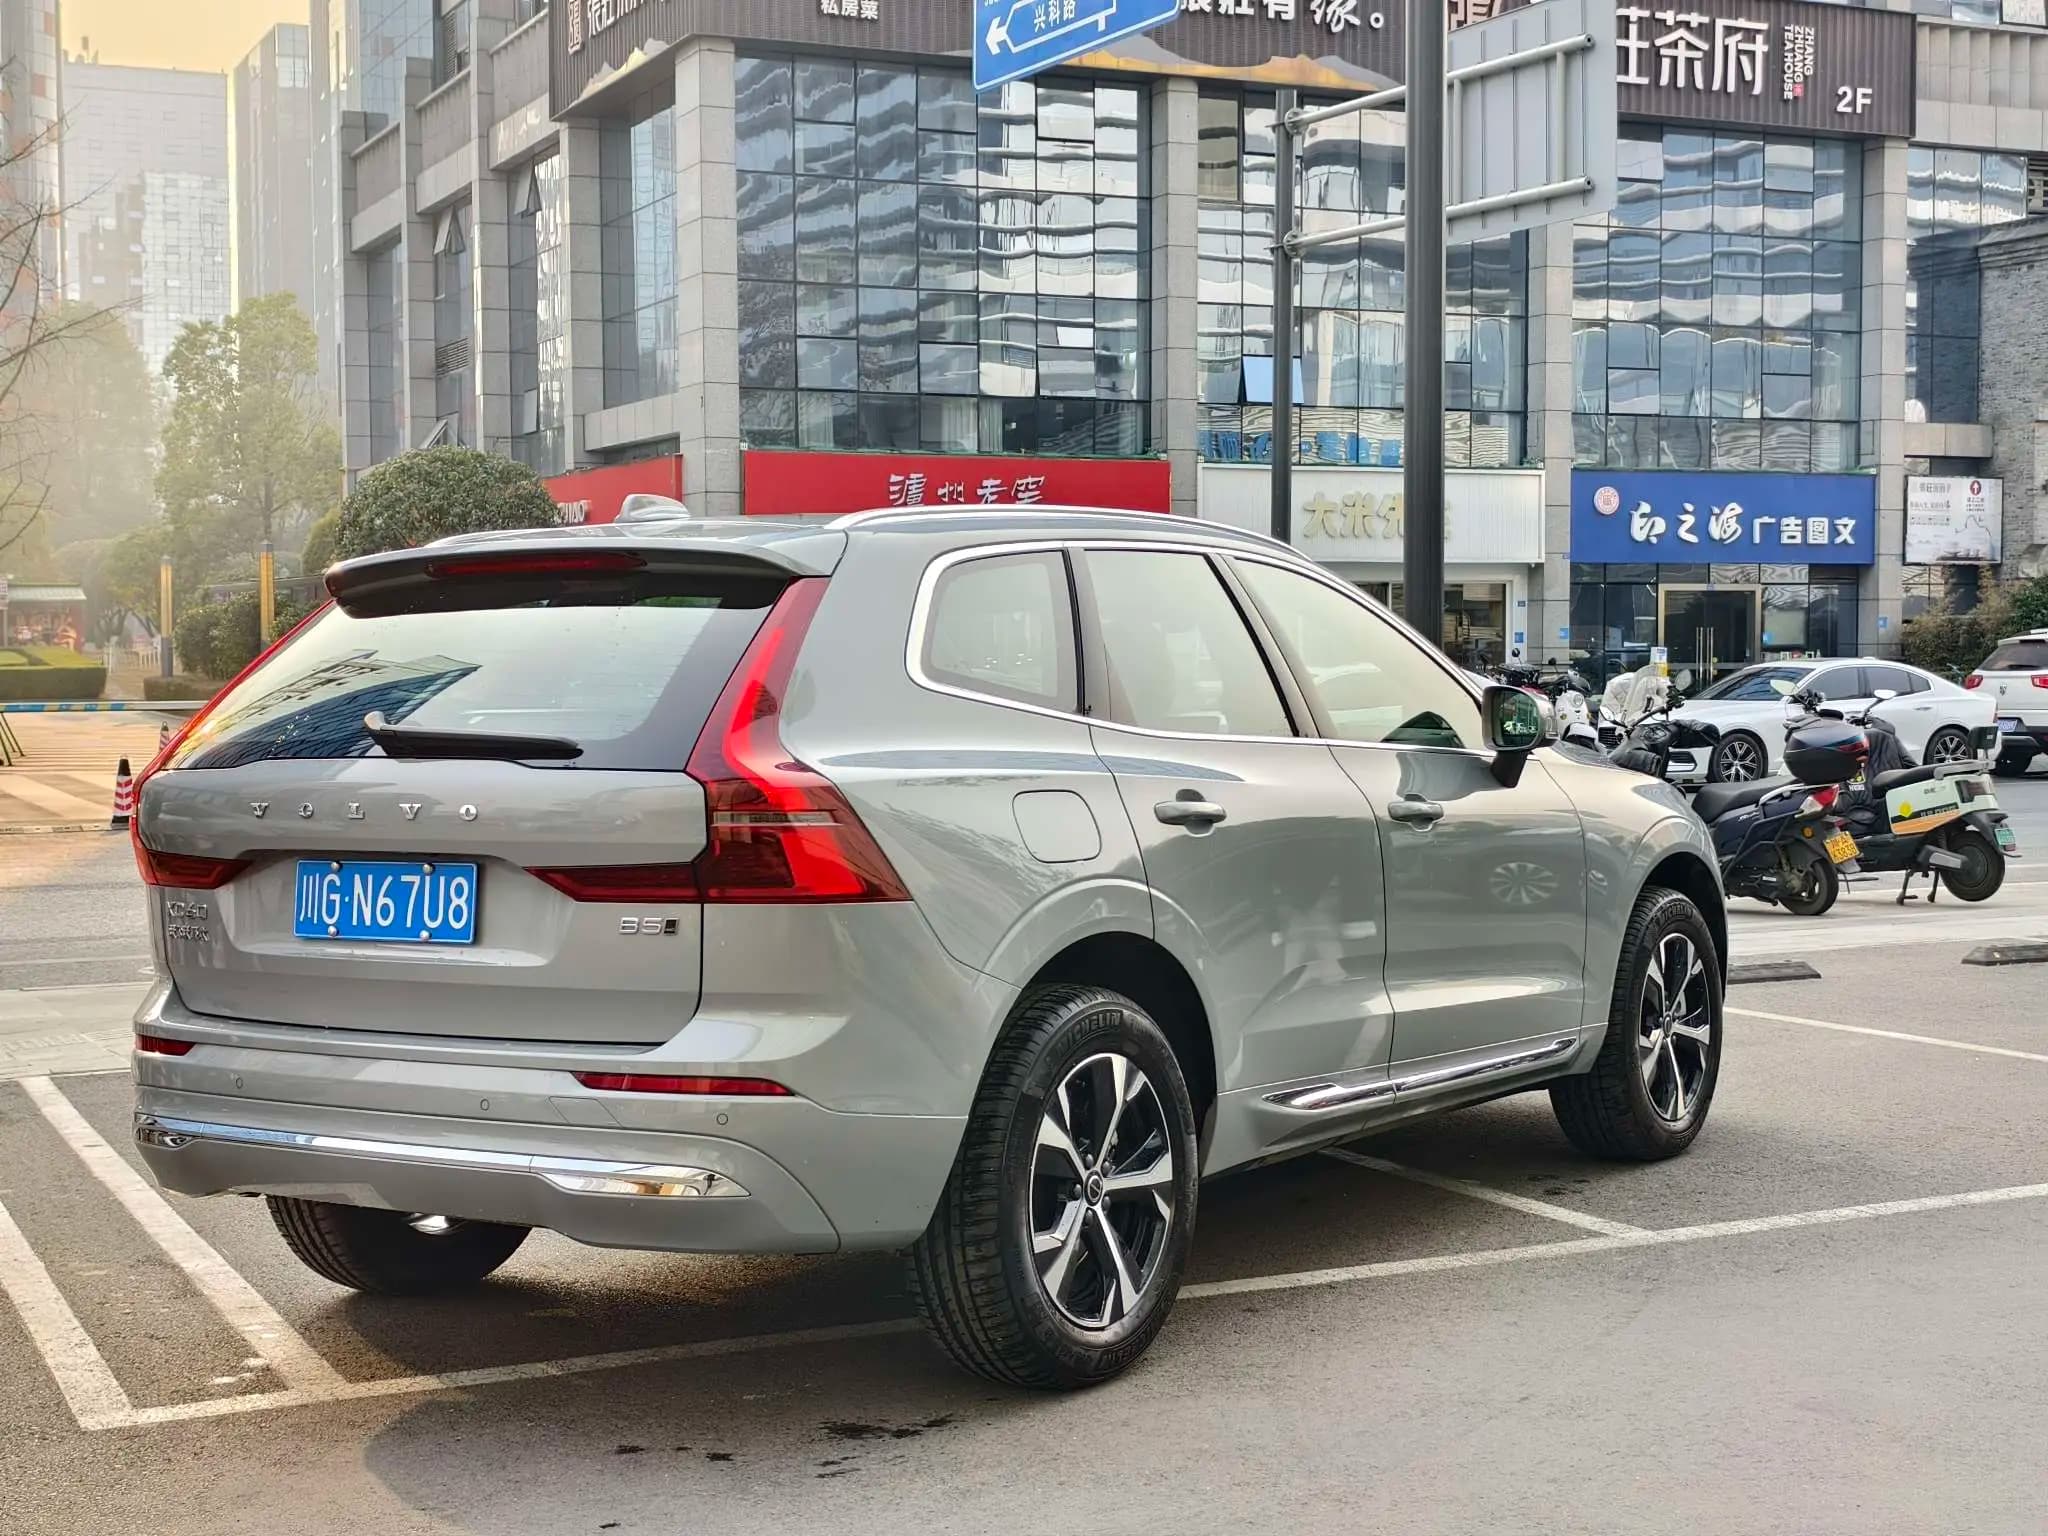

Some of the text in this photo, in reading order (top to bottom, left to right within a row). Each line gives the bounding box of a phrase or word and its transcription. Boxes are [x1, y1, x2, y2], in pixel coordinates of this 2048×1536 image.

[1033, 0, 1076, 33] 兴科路
[1794, 25, 1804, 83] ZHUANG
[1804, 27, 1815, 76] ZHANG
[1836, 86, 1873, 114] 2F
[1303, 491, 1453, 540] 大米先
[250, 802, 478, 822] VOLVO
